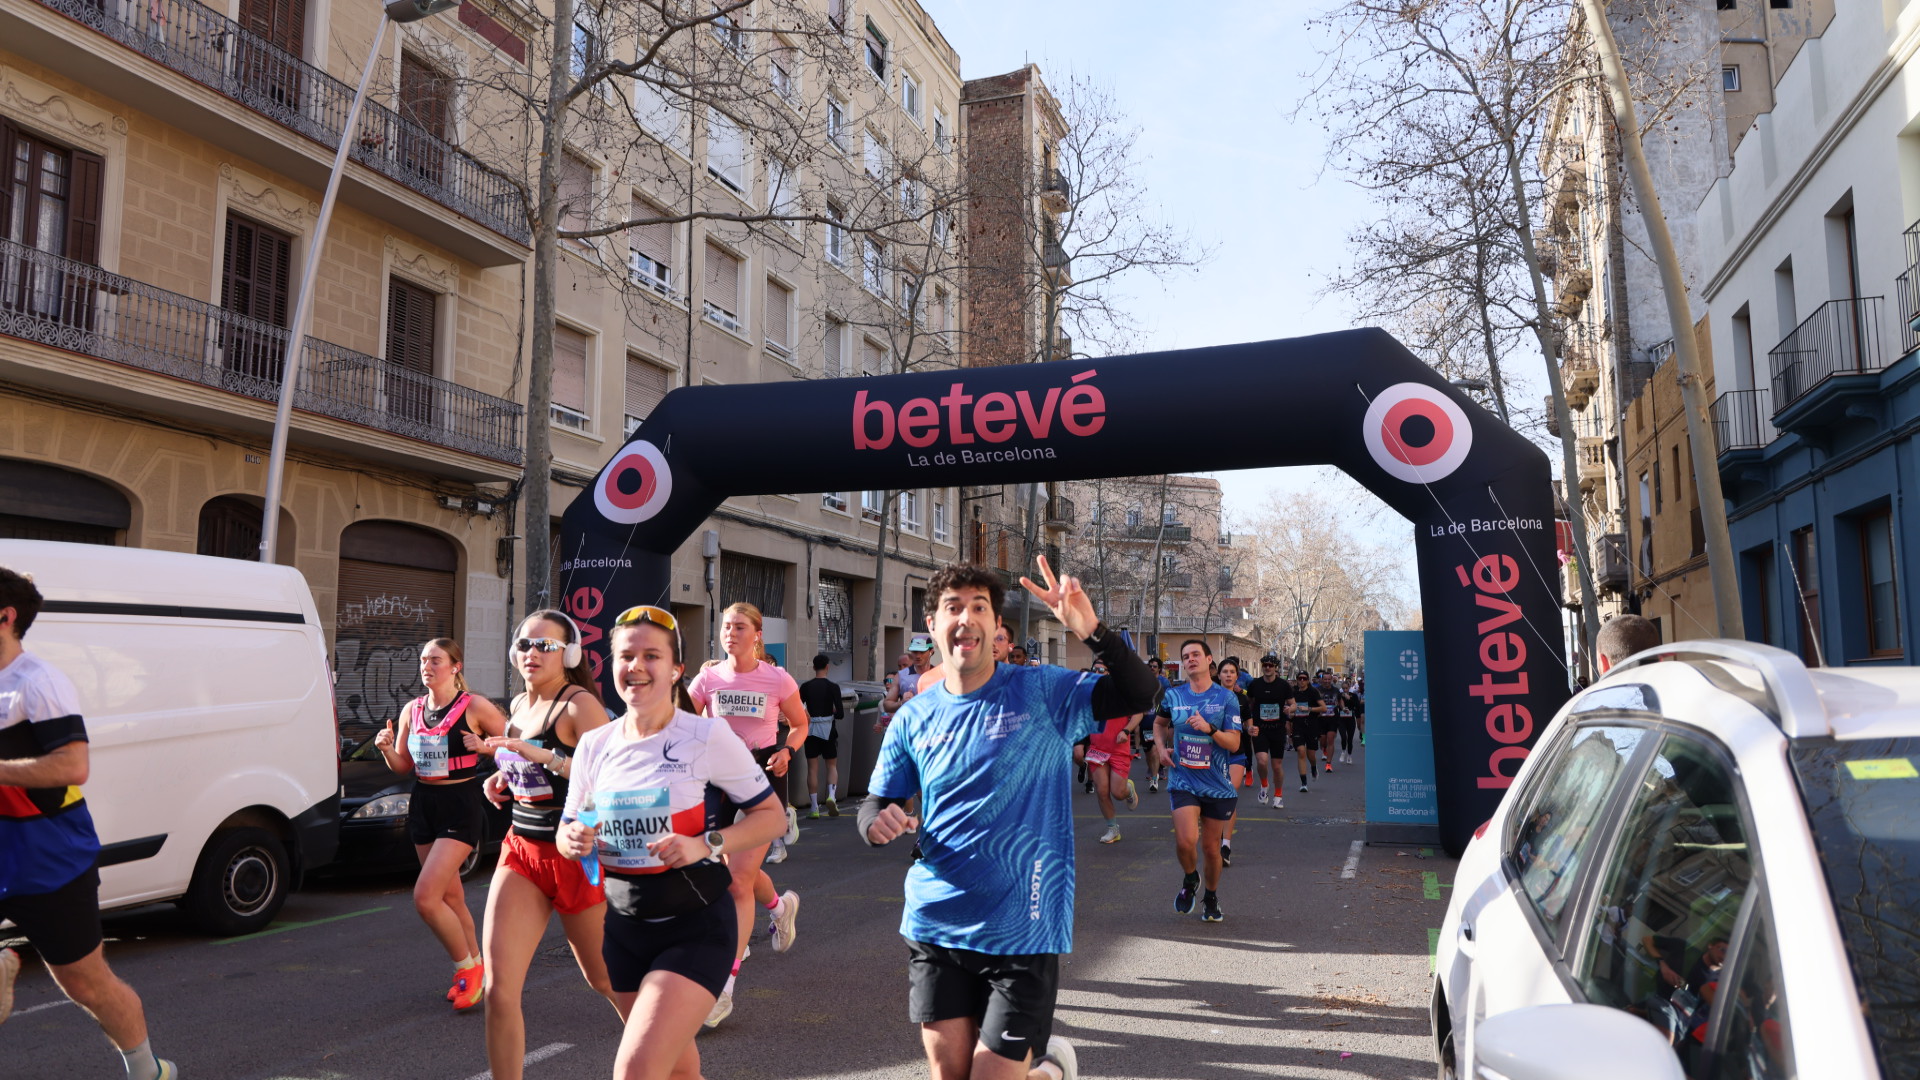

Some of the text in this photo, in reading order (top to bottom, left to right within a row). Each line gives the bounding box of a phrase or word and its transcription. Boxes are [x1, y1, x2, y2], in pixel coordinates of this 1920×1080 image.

[853, 369, 1106, 450] betevé
[907, 446, 1057, 467] La de Barcelona
[1431, 517, 1543, 536] La de Barcelona
[574, 557, 632, 569] Barcelona
[1400, 649, 1418, 681] 9
[1455, 554, 1534, 790] betevé
[718, 695, 764, 706] ISABELLE
[423, 751, 447, 760] KELLY
[1186, 745, 1202, 754] PAU
[611, 795, 656, 806] HYUNDAI
[1388, 806, 1429, 816] Barcelona
[596, 816, 670, 837] ARGAUX
[615, 838, 643, 850] 18312
[617, 858, 646, 866] BROOKS
[1030, 860, 1042, 920] 21.097m
